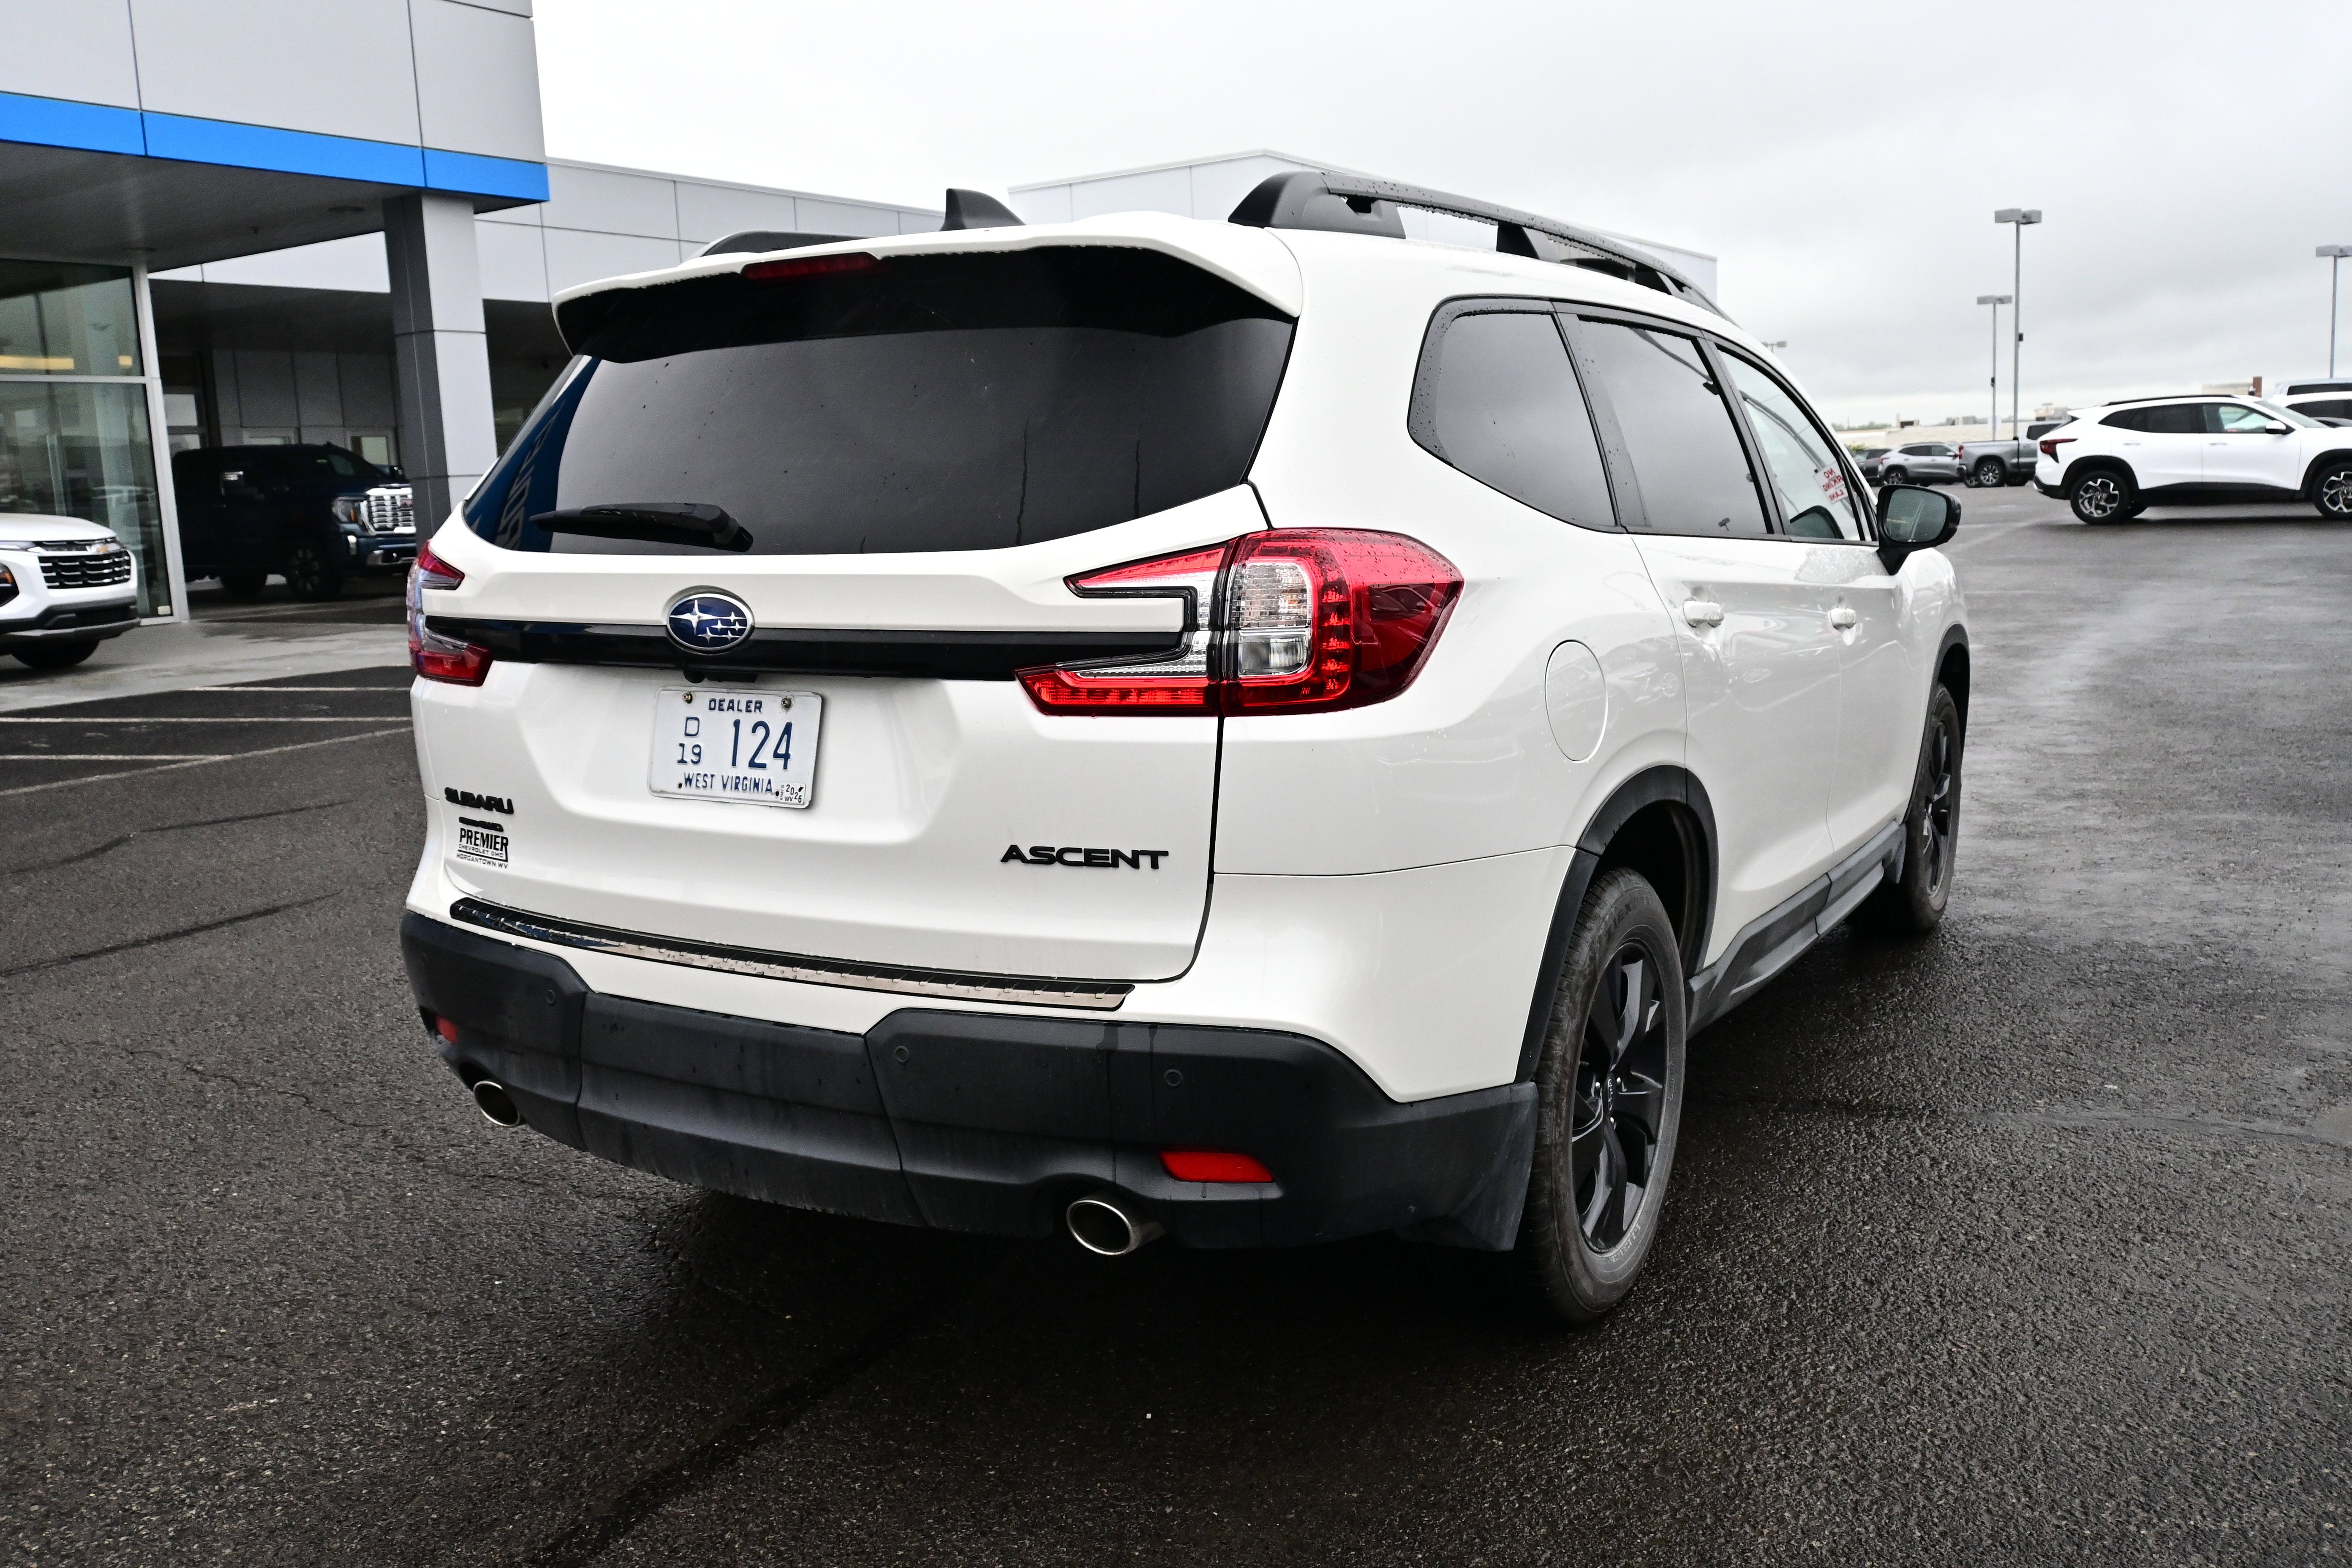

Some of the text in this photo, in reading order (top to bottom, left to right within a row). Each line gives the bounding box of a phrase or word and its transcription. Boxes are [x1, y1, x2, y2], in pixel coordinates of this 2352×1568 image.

[709, 698, 762, 713] DEALER
[684, 716, 700, 736] D
[677, 743, 702, 764] 19
[732, 719, 792, 770] 124
[684, 773, 773, 794] WEST VIRGINIA
[786, 784, 802, 803] 2026
[444, 787, 514, 814] SUBARU
[460, 828, 509, 852] PREMIER
[456, 852, 509, 869] MORGANTOWN WV
[459, 844, 504, 858] CHEVROLET GMC
[1000, 844, 1169, 869] ASCENT
